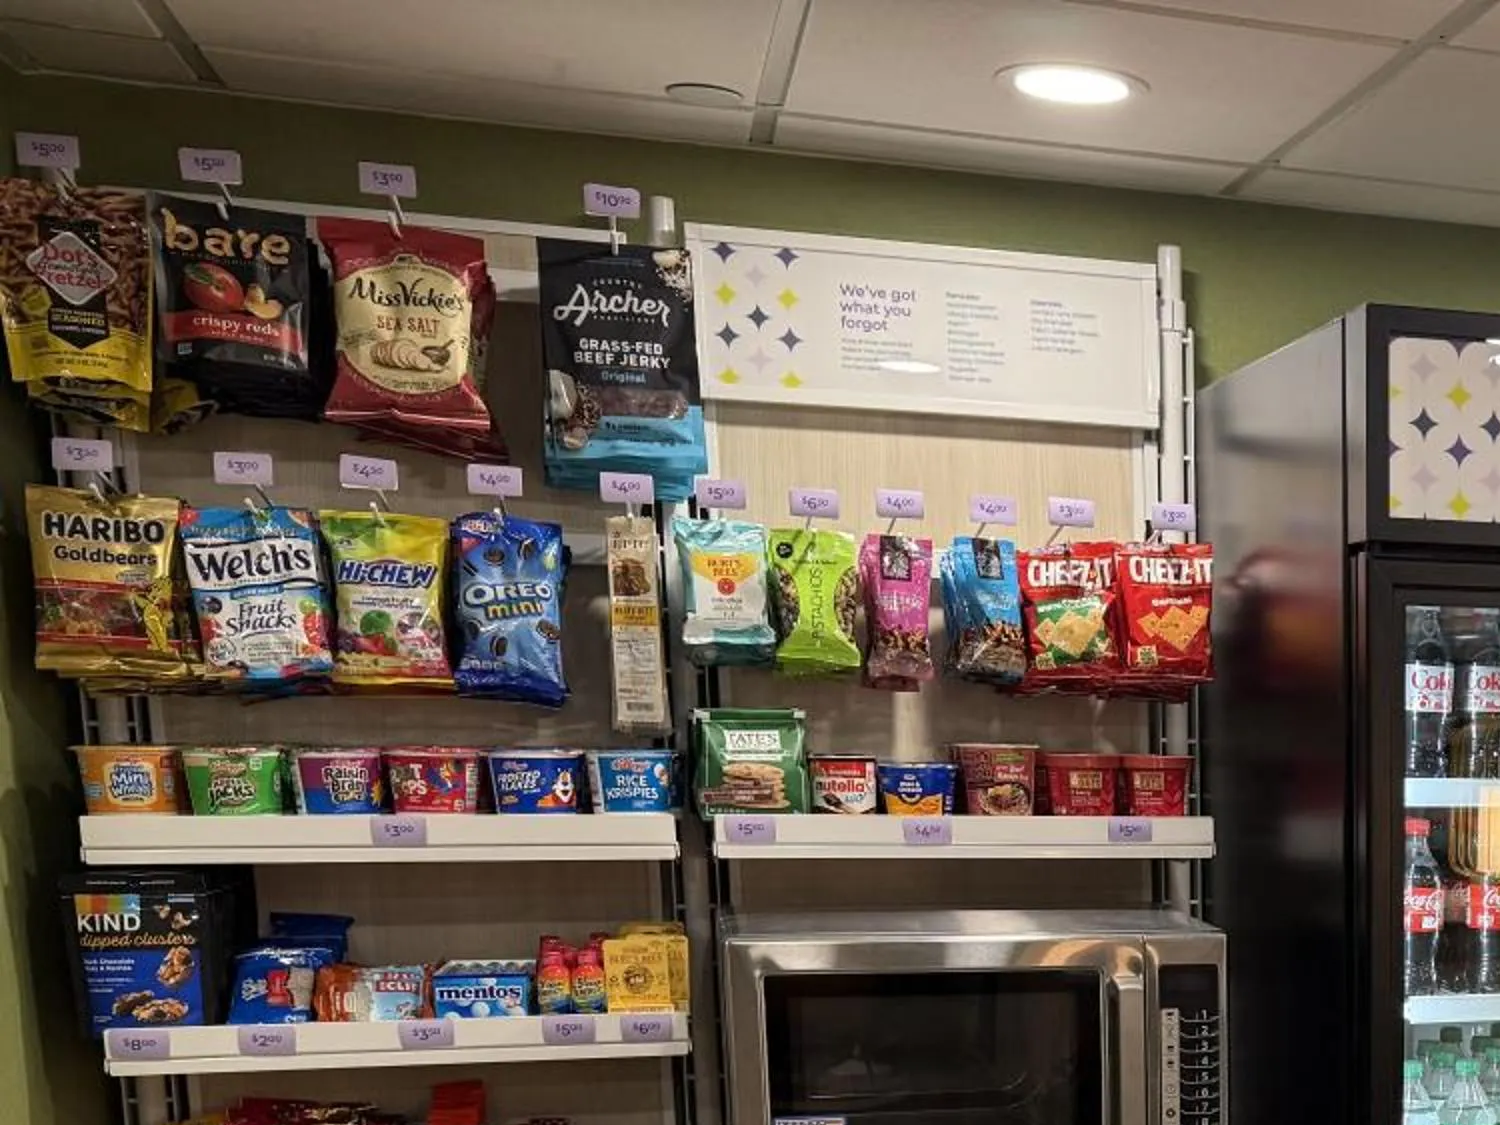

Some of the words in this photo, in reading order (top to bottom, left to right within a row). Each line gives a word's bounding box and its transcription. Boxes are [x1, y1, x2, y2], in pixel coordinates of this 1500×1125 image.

[161, 208, 291, 265] bare
[349, 277, 401, 307] Miss
[396, 278, 465, 317] Vickie's
[840, 284, 887, 300] We've
[891, 288, 917, 303] got
[553, 283, 671, 327] Archer
[840, 300, 880, 316] what
[883, 305, 912, 318] you
[193, 314, 242, 331] crispy
[377, 315, 402, 332] SEA
[407, 316, 441, 334] SALT
[840, 315, 888, 333] forgot
[579, 337, 664, 355] GRASS-FED
[573, 351, 615, 366] BEEF
[619, 354, 671, 369] JERKY
[41, 512, 166, 544] HARIBO
[53, 545, 158, 567] Goldbears
[188, 543, 312, 581] Welch's
[464, 583, 552, 607] OREO
[239, 599, 287, 617] Fruit
[486, 601, 545, 620] mini
[226, 614, 297, 637] Snacks
[323, 766, 369, 781] Raisin
[615, 774, 648, 787] RICE
[606, 786, 660, 800] KRISPIES
[814, 777, 867, 794] nutella
[208, 785, 255, 808] JACKS
[76, 913, 142, 933] KIND
[79, 931, 132, 950] dipped
[133, 931, 197, 946] clusters
[436, 985, 522, 1000] mentos
[1201, 1009, 1208, 1020] 1
[1201, 1025, 1208, 1035] 2
[1201, 1056, 1208, 1065] 4
[1201, 1071, 1208, 1081] 5
[1201, 1102, 1208, 1111] 7
